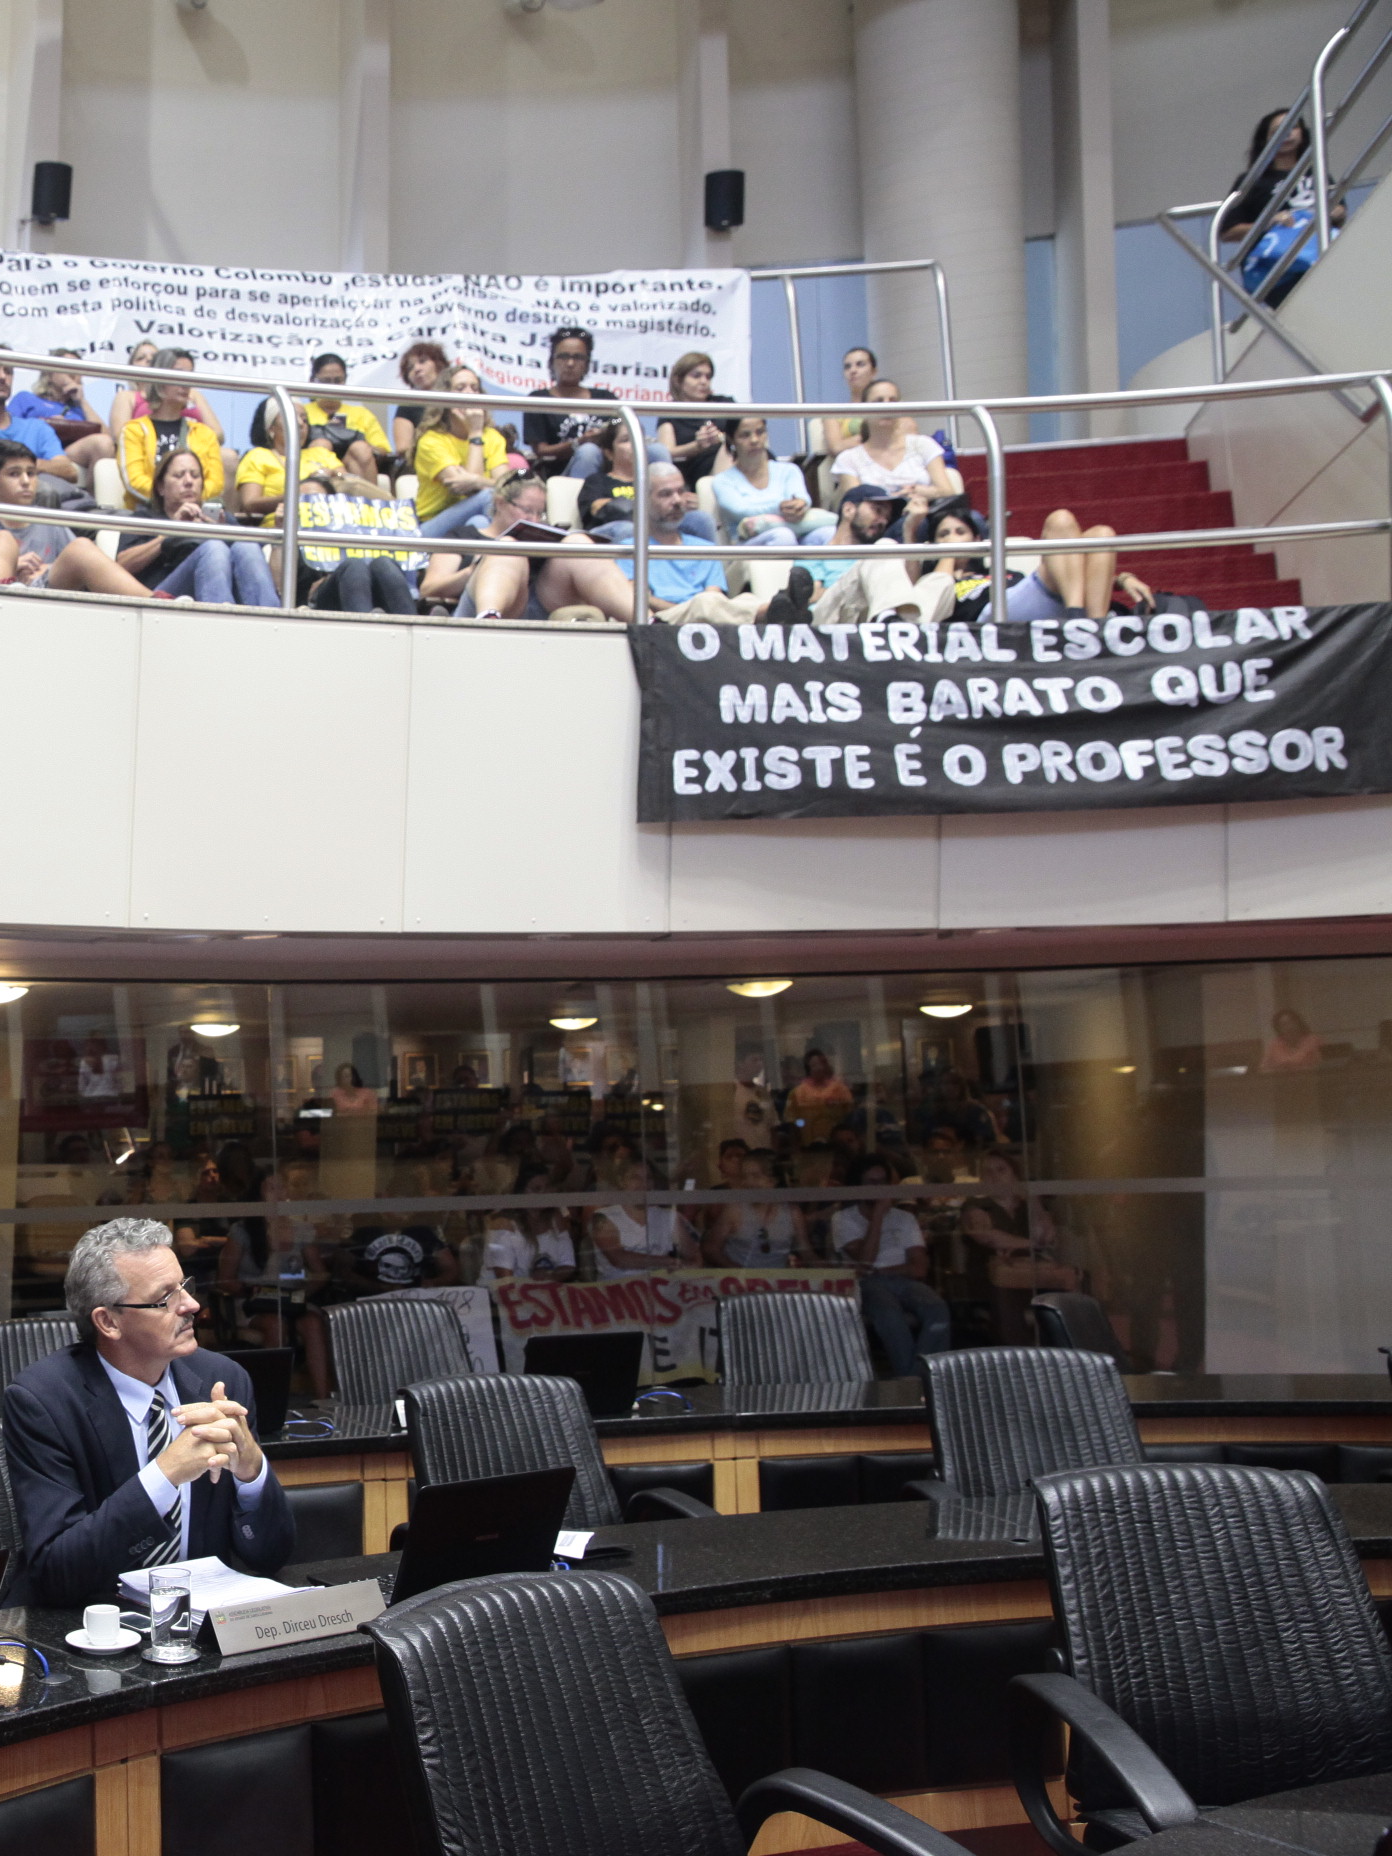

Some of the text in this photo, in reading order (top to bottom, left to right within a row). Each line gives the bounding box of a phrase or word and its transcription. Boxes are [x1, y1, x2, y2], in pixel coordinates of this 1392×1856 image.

[88, 257, 205, 278] Governo
[214, 265, 333, 287] Colombo
[67, 278, 91, 293] se
[98, 275, 188, 297] esforçou
[195, 285, 241, 301] para
[248, 289, 271, 303] se
[399, 297, 424, 309] na
[1, 302, 48, 317] Com
[56, 299, 103, 316] esta
[194, 303, 218, 321] de
[134, 319, 323, 348] Valorização
[335, 335, 374, 347] da
[453, 339, 542, 369] tabela
[677, 606, 1312, 663] O MATERIAL ESCOLAR
[719, 657, 1276, 724] MAIS BARATO QUE
[673, 726, 1348, 795] EXISTE É O PROFESSOR
[501, 1277, 682, 1330] ESTAMOS
[254, 1609, 354, 1640] Dep. Dirceu Dresch
